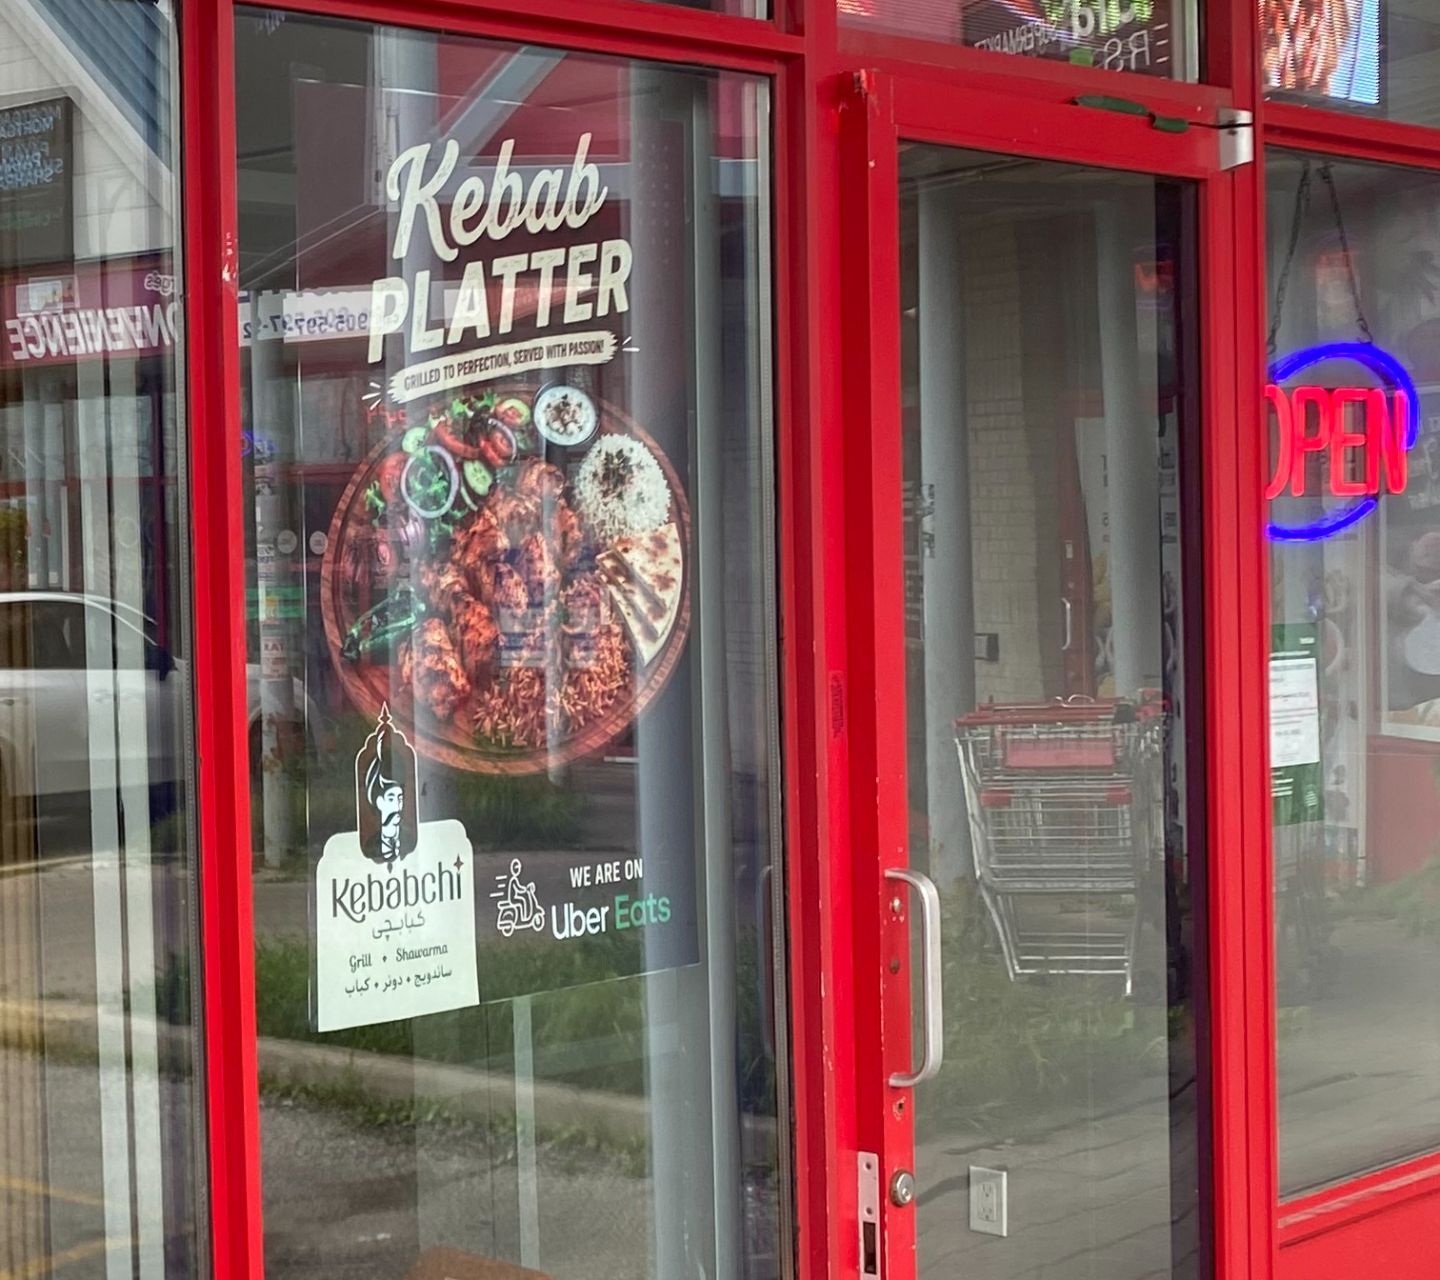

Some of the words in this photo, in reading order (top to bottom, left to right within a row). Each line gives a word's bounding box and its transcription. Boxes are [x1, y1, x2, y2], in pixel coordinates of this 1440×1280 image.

[386, 132, 608, 263] Kebab
[367, 239, 633, 364] PLATTER
[403, 368, 441, 391] GRILLED
[443, 364, 455, 380] TO
[457, 352, 512, 376] PERFECTION,
[513, 347, 544, 365] SERVED
[546, 343, 568, 360] WITH
[568, 339, 605, 357] PASSION!
[332, 854, 464, 923] Kebabchi
[569, 865, 591, 888] WE
[595, 861, 621, 885] ARE
[624, 858, 643, 880] ON
[551, 902, 609, 940] Uber
[615, 892, 671, 930] Eats
[349, 953, 372, 973] Grill
[396, 944, 448, 962] Shawarma
